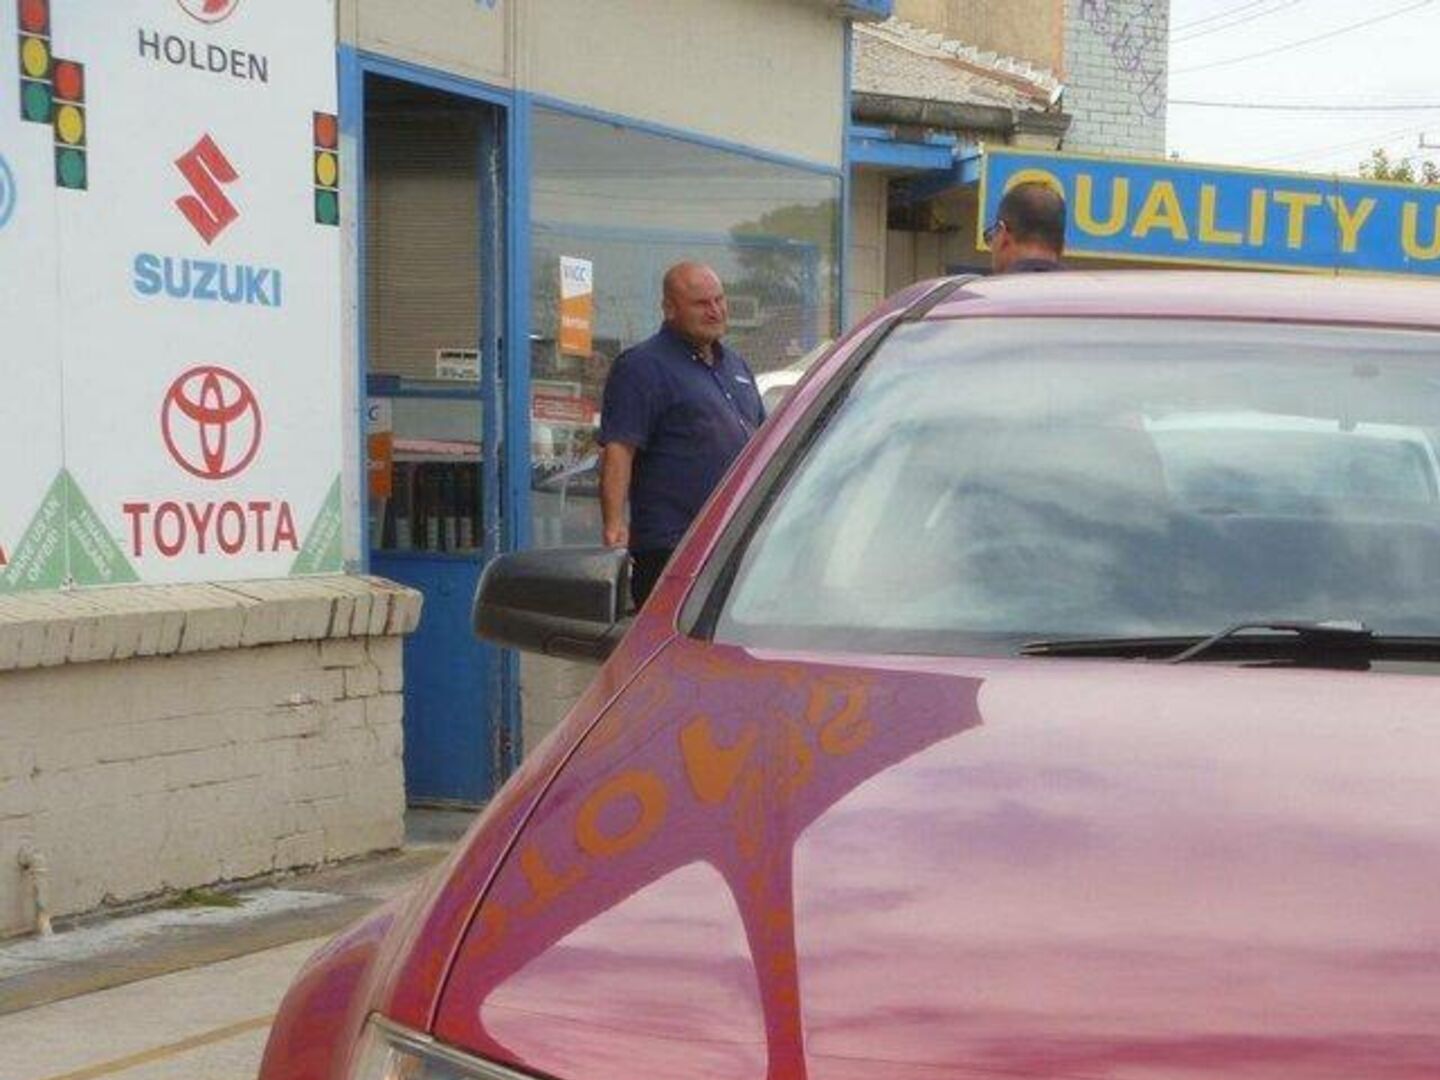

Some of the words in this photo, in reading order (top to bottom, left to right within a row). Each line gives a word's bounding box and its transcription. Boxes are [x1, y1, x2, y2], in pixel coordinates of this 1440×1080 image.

[138, 29, 269, 83] HOLDEN
[1004, 167, 1378, 253] UALITY
[133, 252, 283, 307] SUZUKI
[123, 501, 300, 557] TOYOTA
